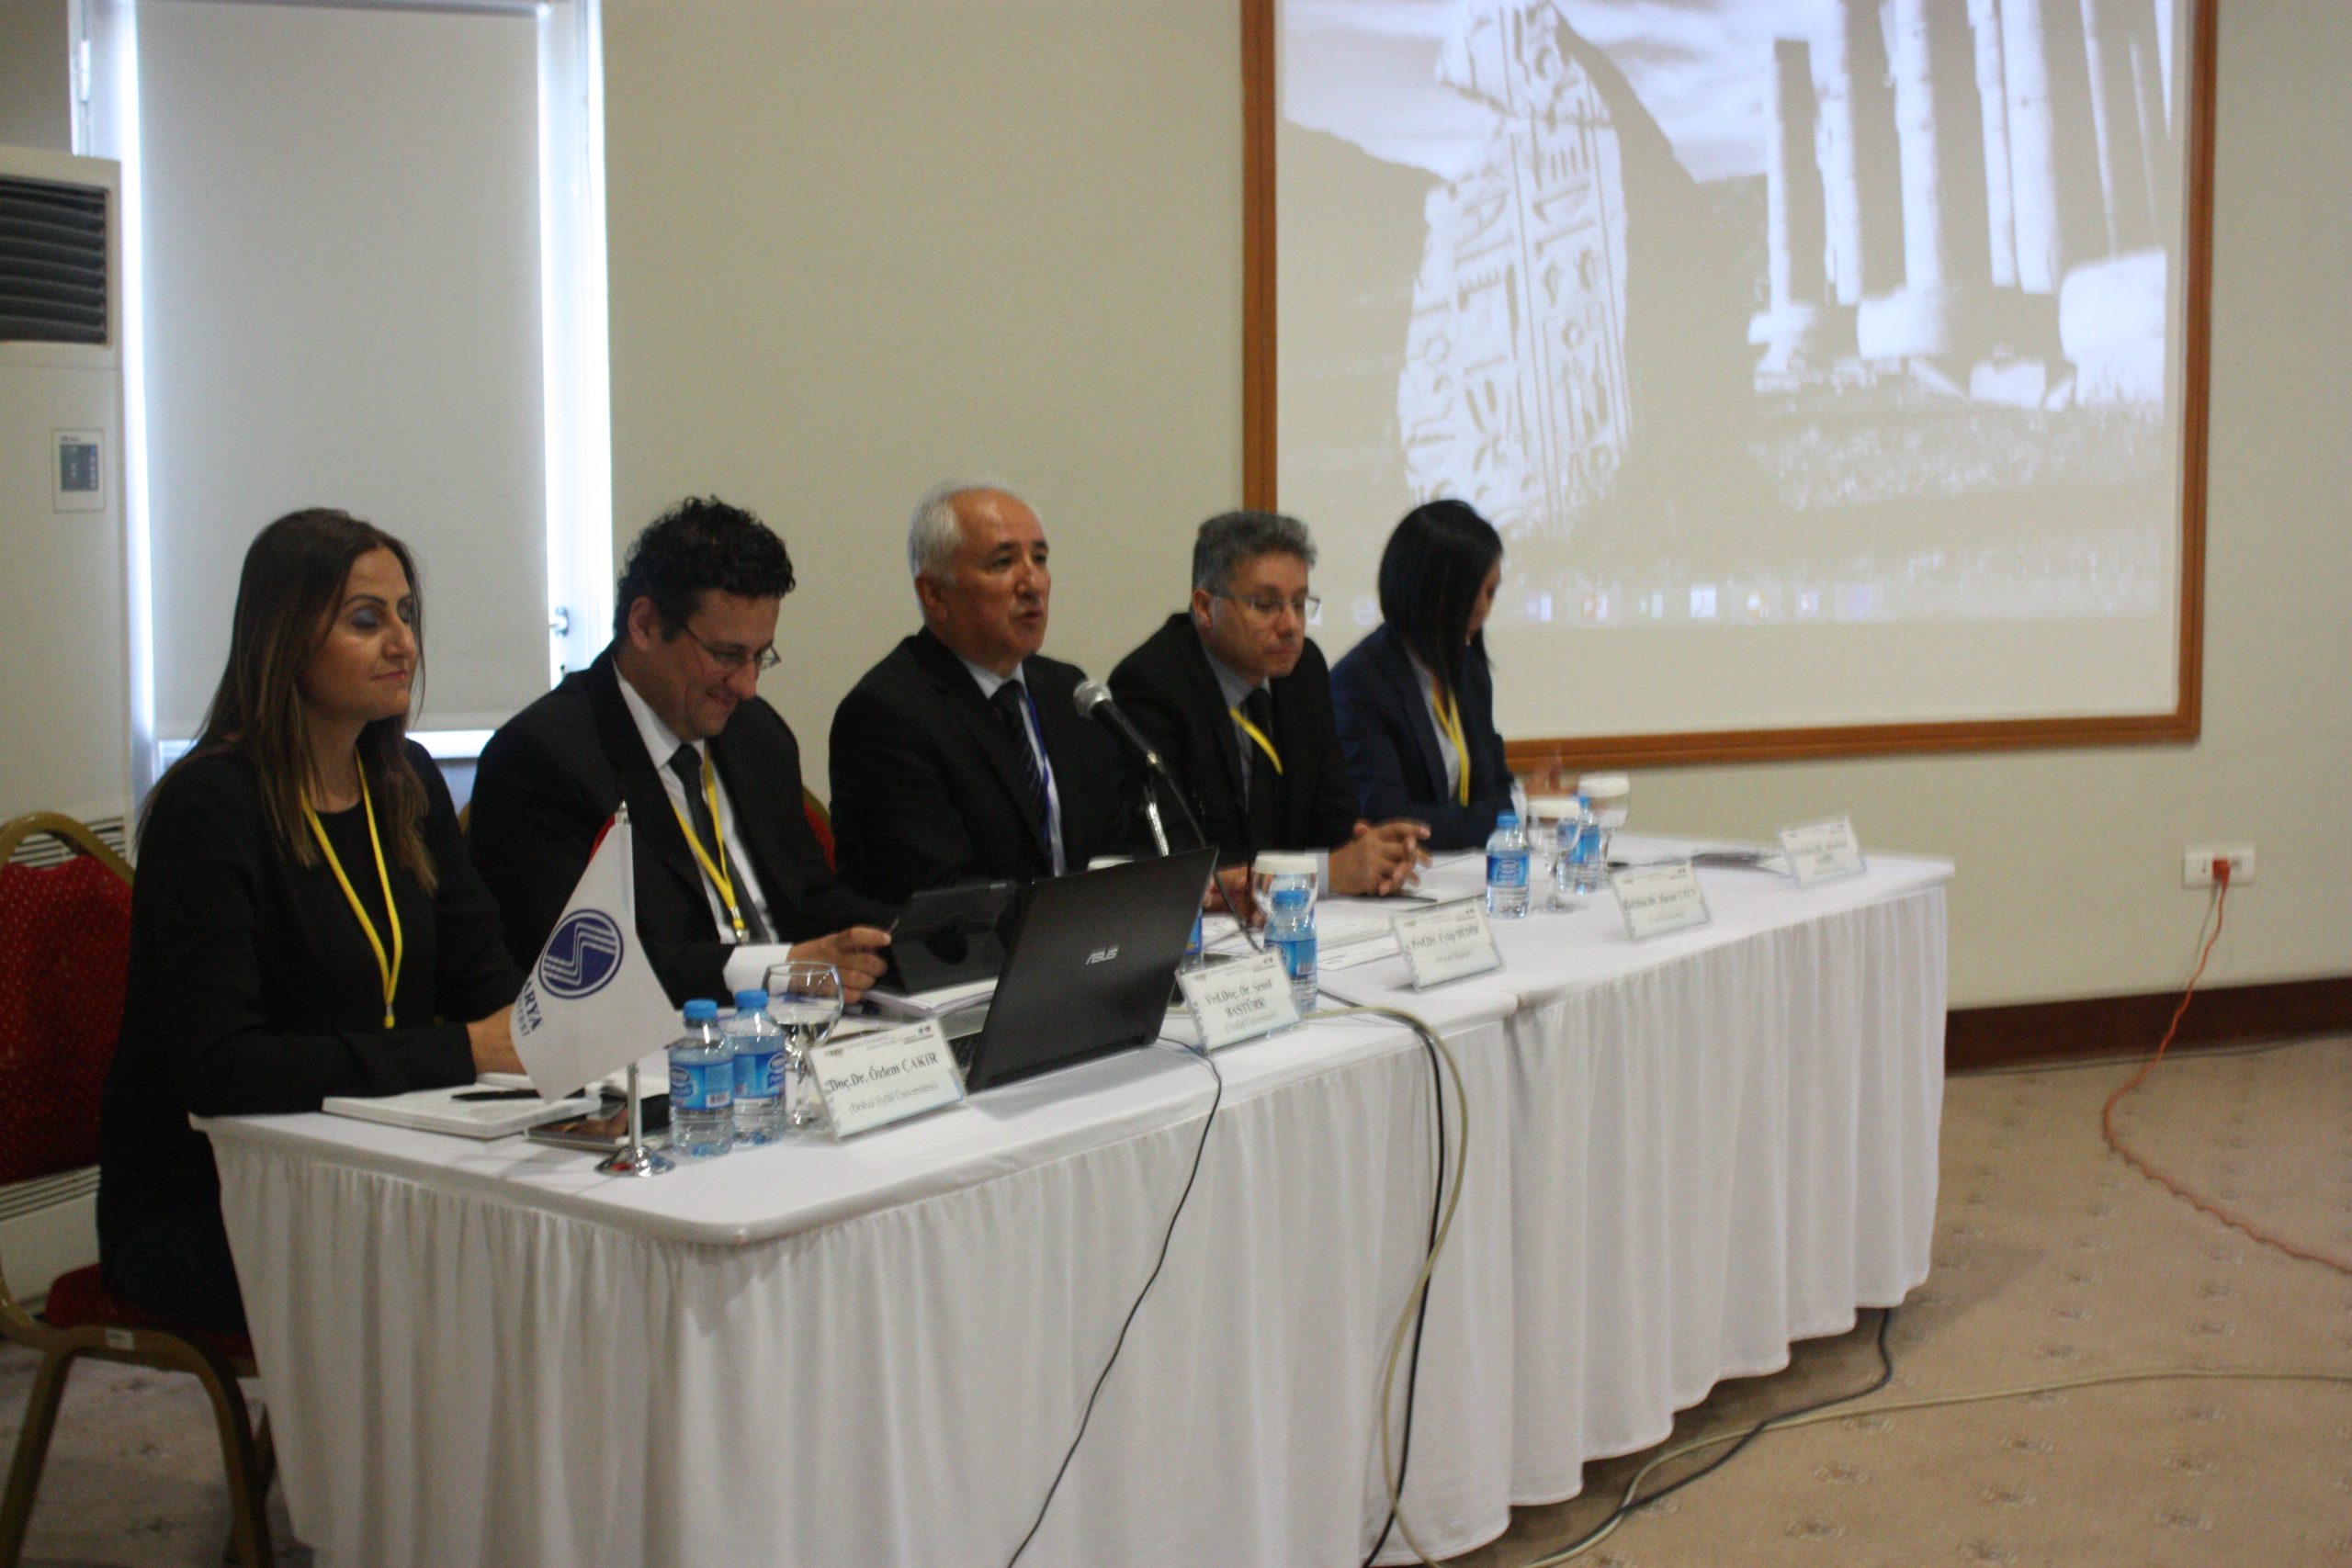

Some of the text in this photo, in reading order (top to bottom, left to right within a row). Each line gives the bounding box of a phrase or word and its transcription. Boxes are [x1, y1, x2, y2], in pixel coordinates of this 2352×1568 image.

[1085, 946, 1119, 965] ASUS
[869, 1064, 900, 1081] Özlem
[901, 1052, 939, 1075] ÇAKIR
